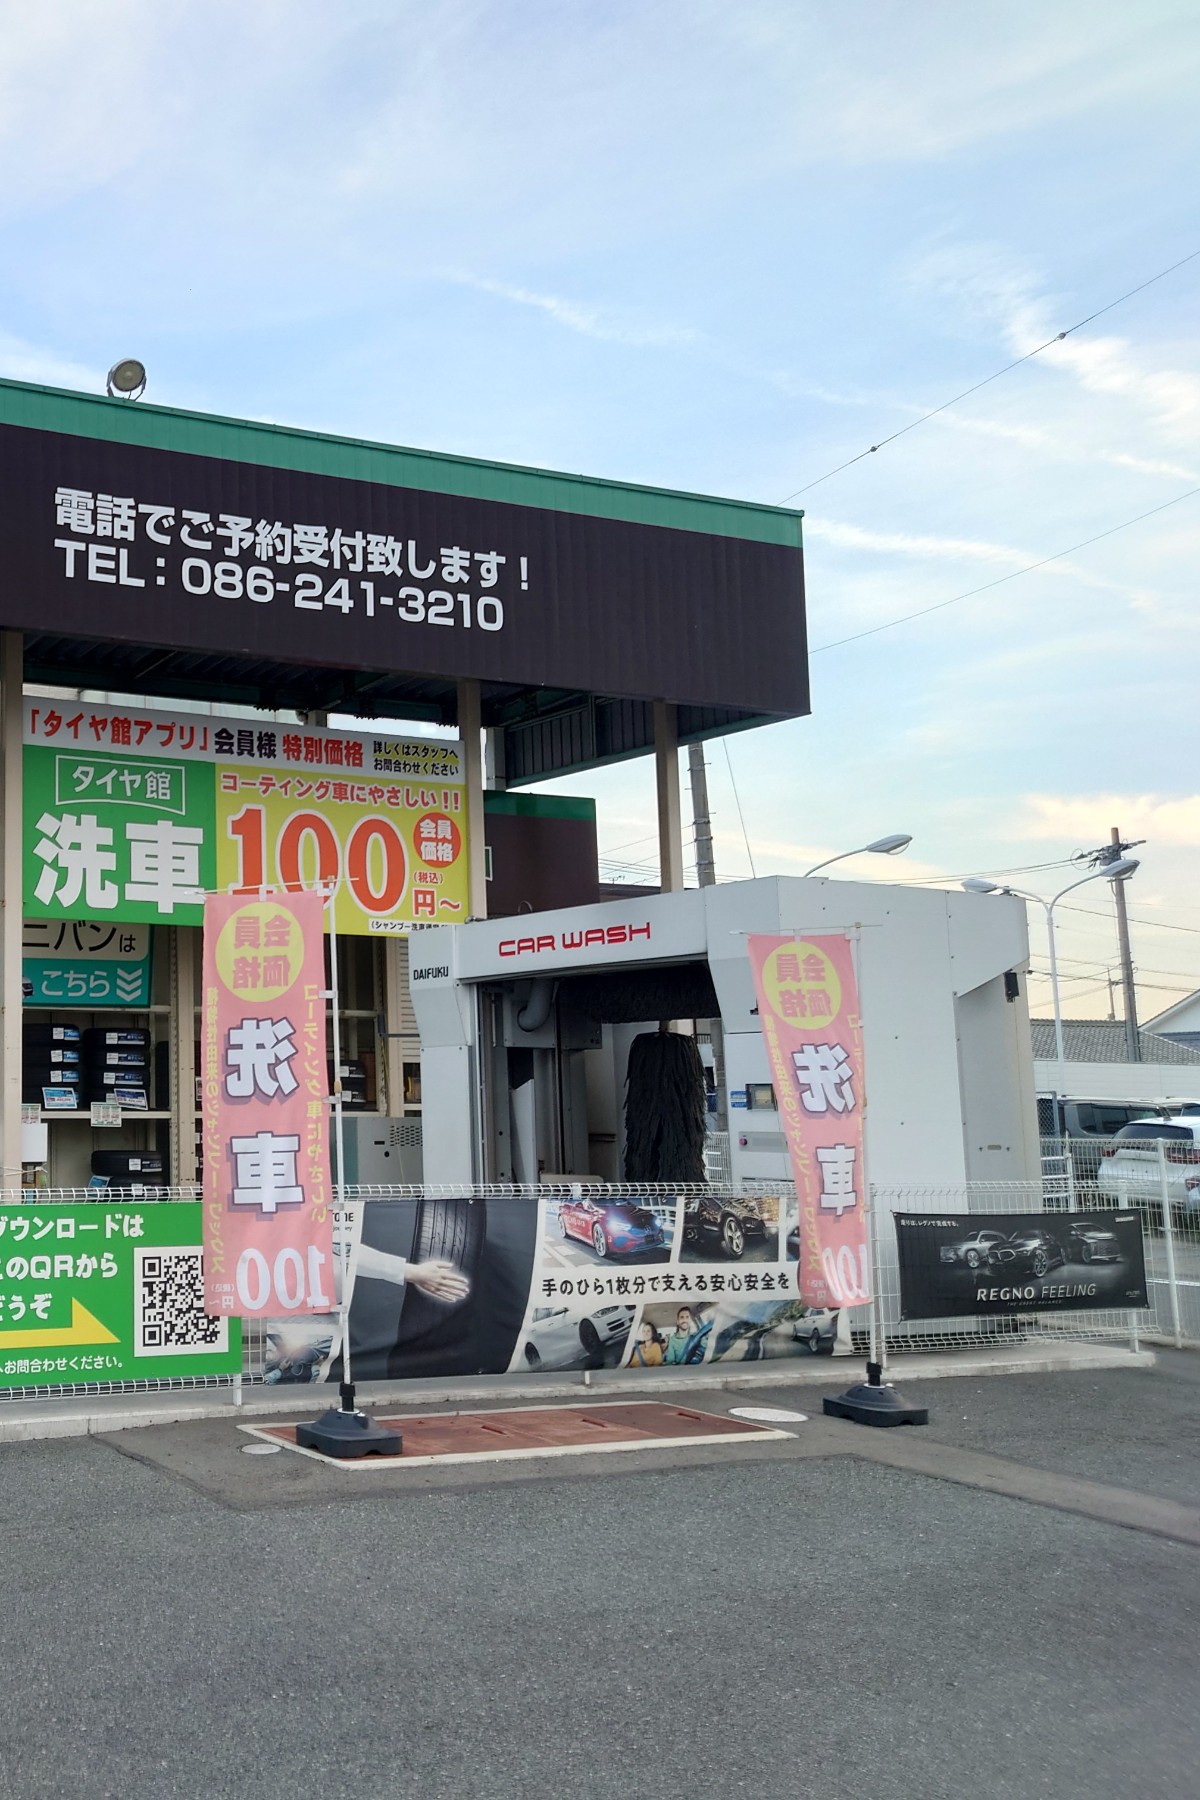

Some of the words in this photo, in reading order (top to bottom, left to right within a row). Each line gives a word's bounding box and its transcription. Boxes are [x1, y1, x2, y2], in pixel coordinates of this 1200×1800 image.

[54, 486, 530, 591] 電話でご予約受付致します！
[282, 733, 364, 768] 特別価格
[373, 740, 459, 760] 詳しくはスタッフへ
[373, 758, 459, 777] お問合わせください
[72, 765, 172, 801] タイヤ館
[419, 818, 453, 840] 会員
[32, 811, 205, 914] 洗車
[228, 803, 408, 916] 100
[420, 840, 454, 862] 価格
[498, 934, 556, 957] CAR
[562, 921, 651, 951] WASH
[41, 970, 110, 997] こちら
[413, 966, 449, 980] DAIFUKU
[976, 1286, 1035, 1301] REGNO
[1041, 1283, 1097, 1299] FEELING
